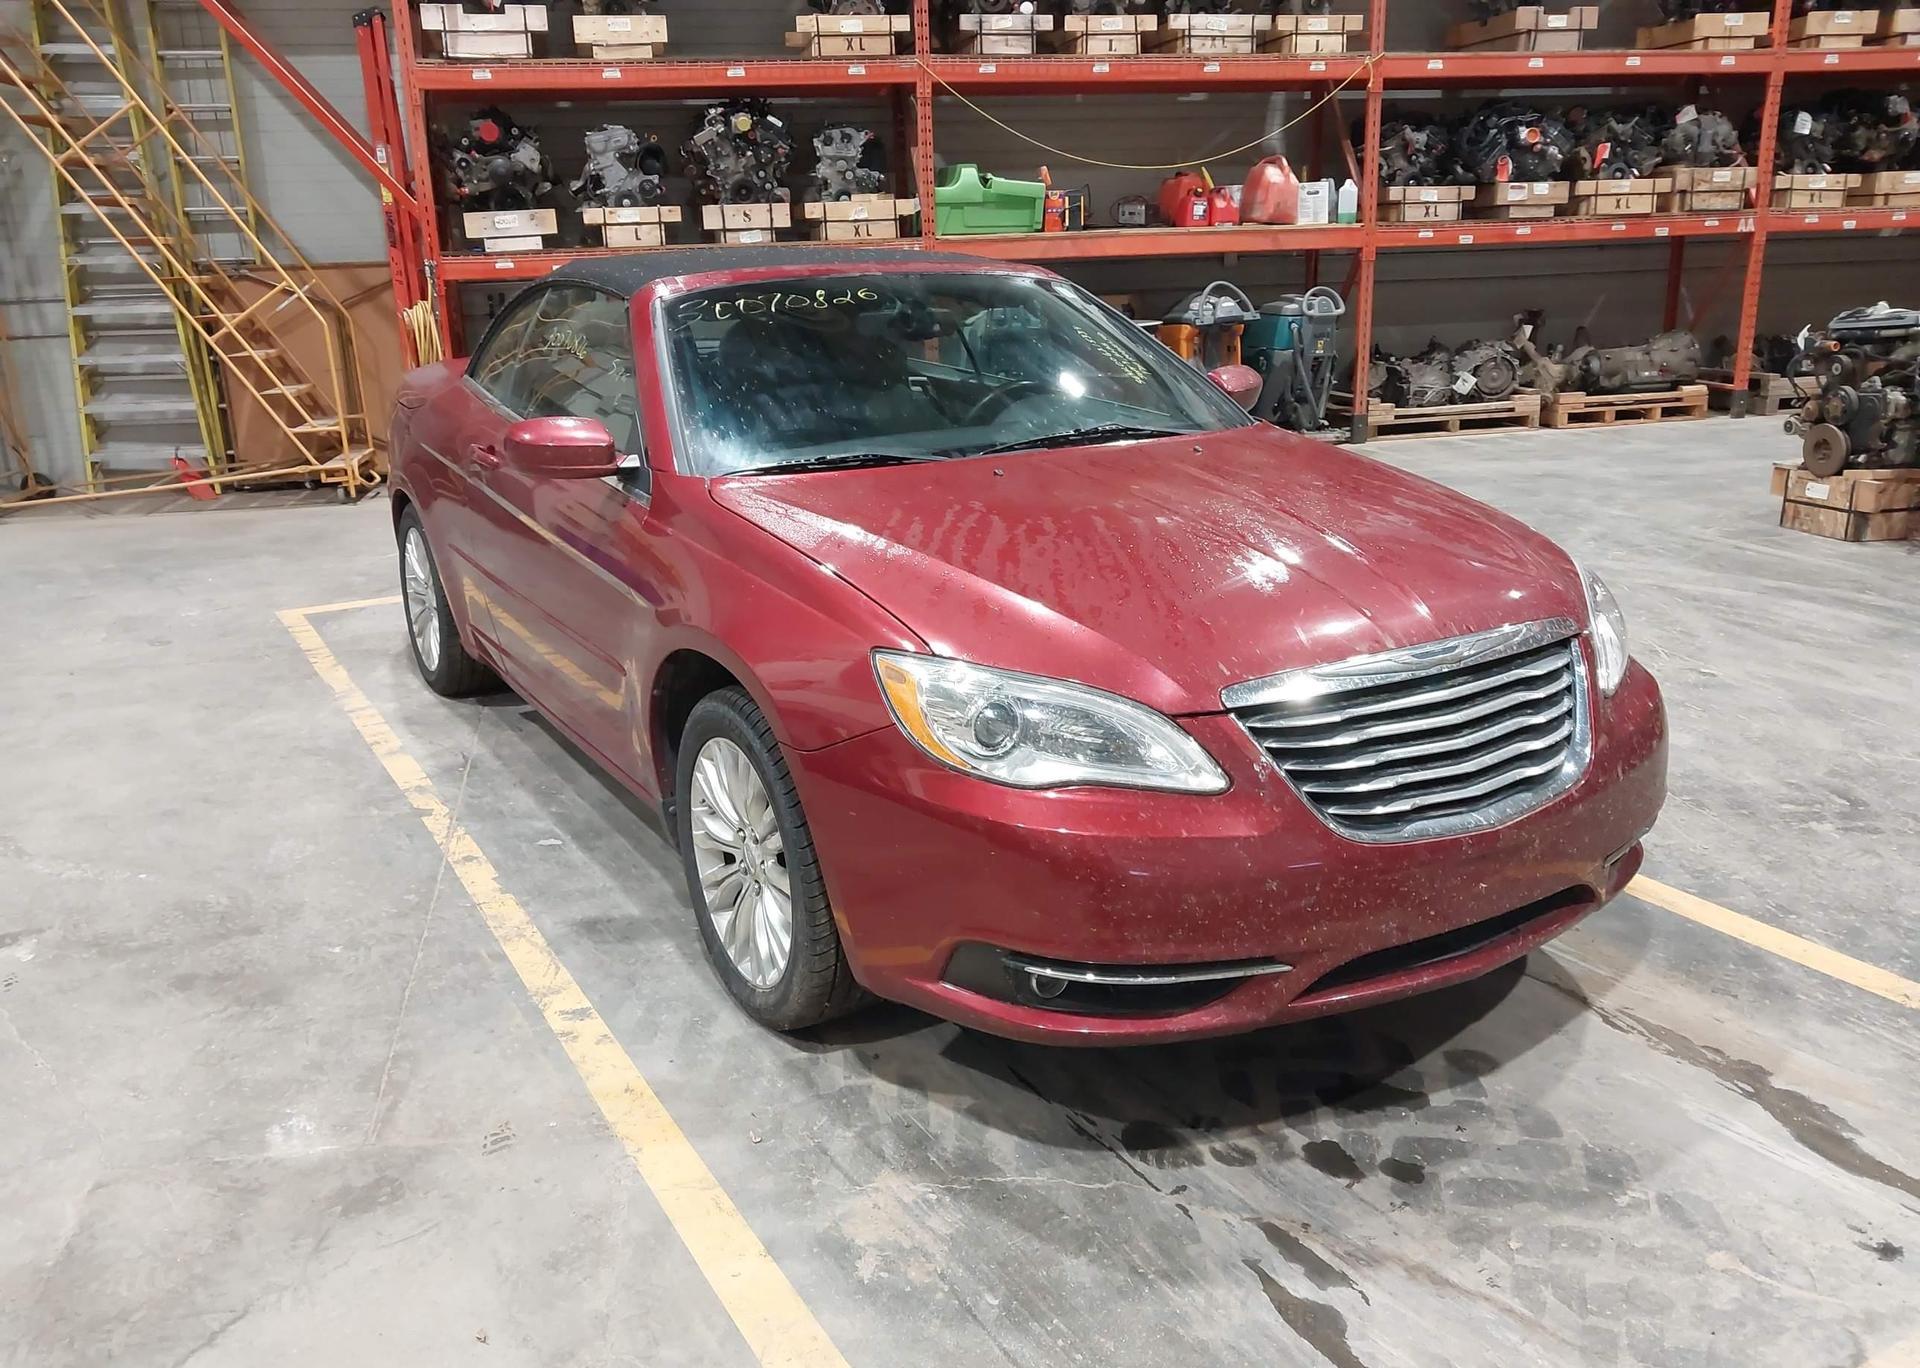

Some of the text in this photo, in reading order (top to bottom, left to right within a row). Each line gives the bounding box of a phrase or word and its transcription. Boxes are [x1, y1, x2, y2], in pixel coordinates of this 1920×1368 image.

[846, 37, 866, 51] XL
[1614, 197, 1632, 210] XL
[742, 209, 752, 223] S
[1423, 204, 1440, 218] XL
[634, 227, 642, 241] L
[853, 224, 873, 238] XL
